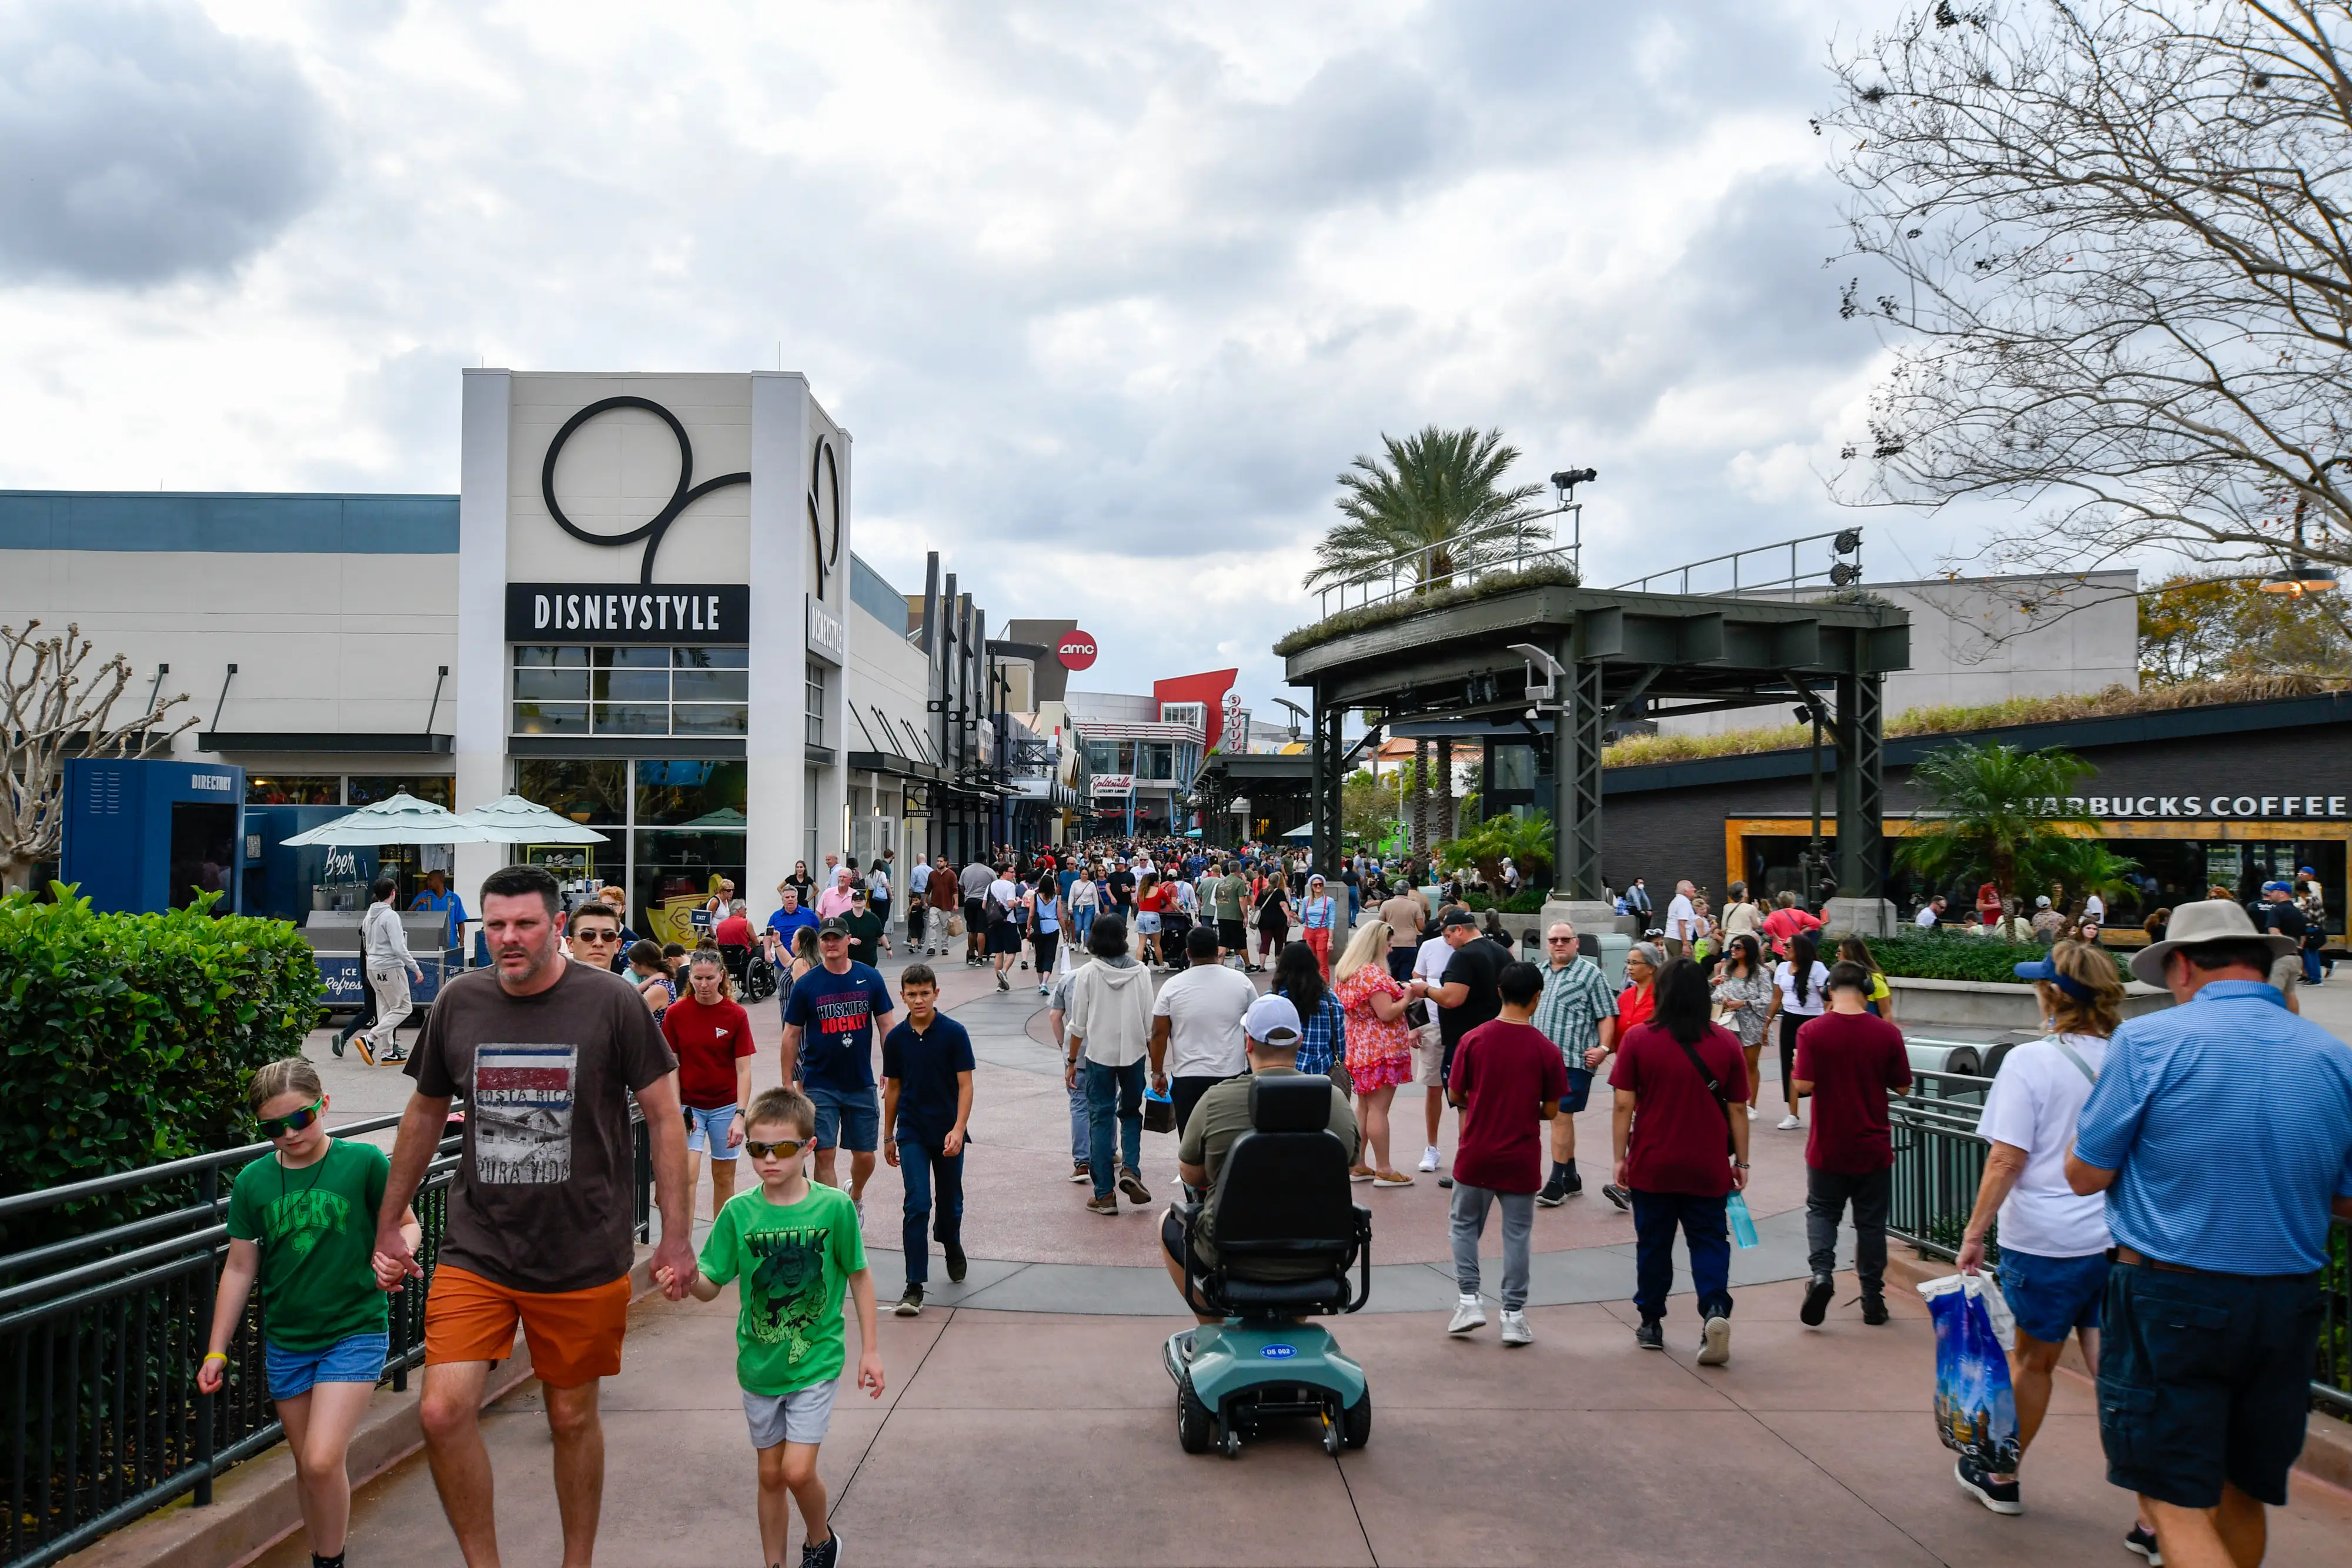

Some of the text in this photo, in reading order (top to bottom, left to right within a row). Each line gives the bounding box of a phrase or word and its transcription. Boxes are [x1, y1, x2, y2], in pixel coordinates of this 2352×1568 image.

[534, 594, 719, 630] DISNEYSTYLE
[811, 606, 841, 655] DISNEYSTYLE
[1059, 644, 1094, 654] amc
[191, 774, 232, 791] DIRECTORY
[1091, 775, 1130, 791] Splitsville
[2210, 796, 2347, 816] COFFEE
[325, 845, 355, 876] Beer
[325, 977, 363, 995] Refres
[377, 973, 388, 981] AX
[817, 1000, 869, 1020] HUSKIES
[476, 1090, 573, 1103] COSTA RICA
[477, 1159, 570, 1184] PURA VIDA
[744, 1227, 830, 1258] HULK
